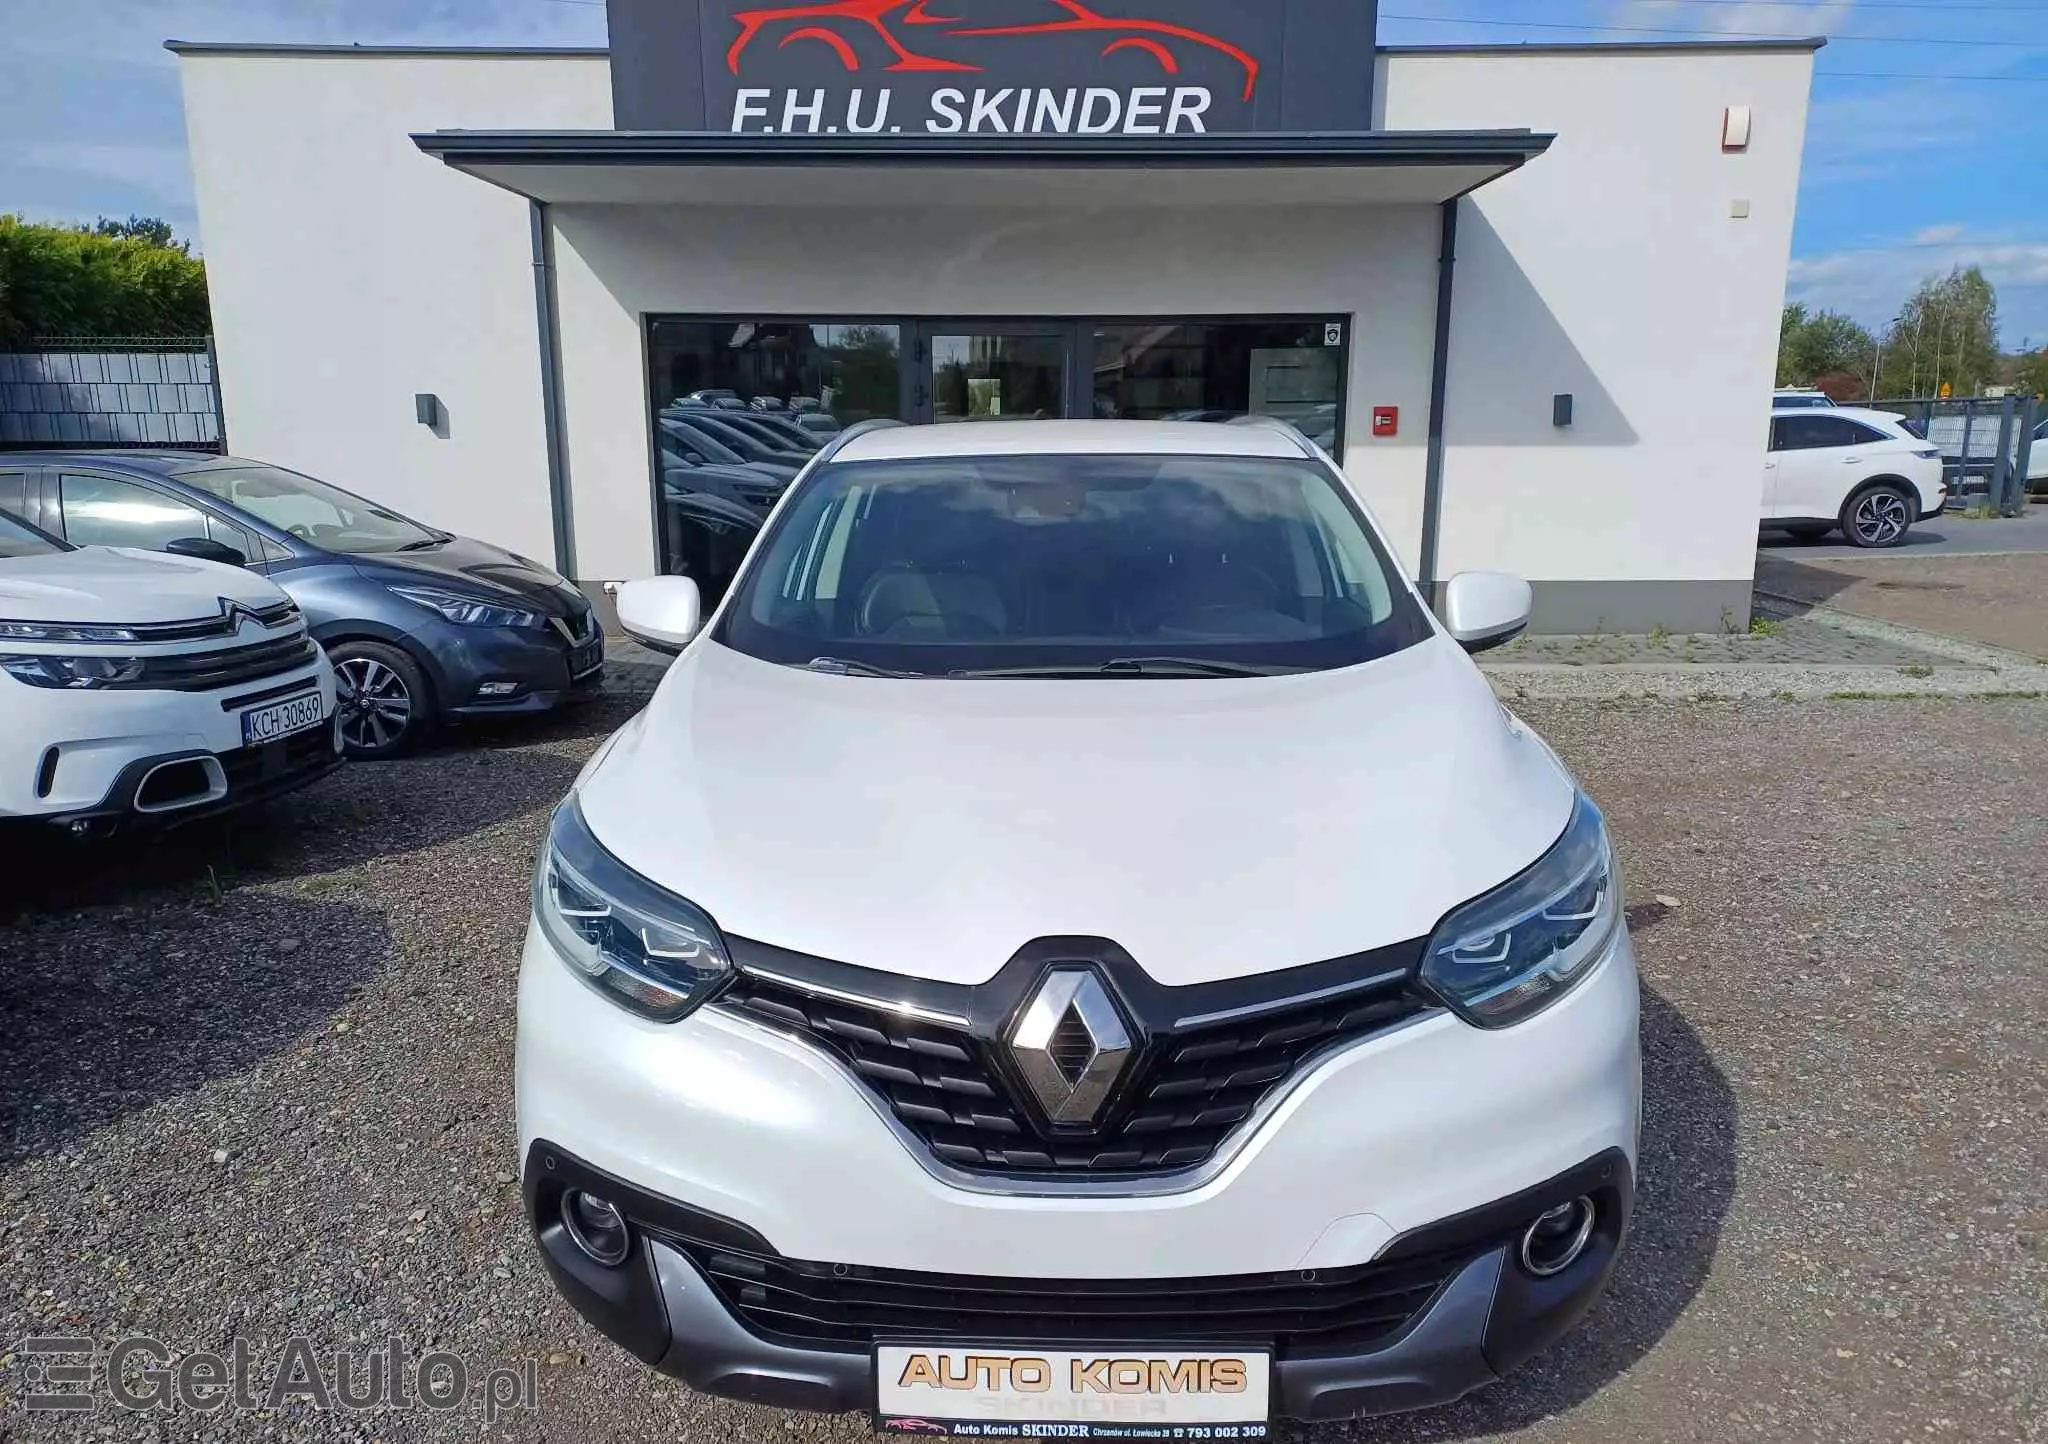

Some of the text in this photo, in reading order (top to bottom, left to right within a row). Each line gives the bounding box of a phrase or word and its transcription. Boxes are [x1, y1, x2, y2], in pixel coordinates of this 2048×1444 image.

[731, 87, 1211, 133] F.H.U. SKINDER
[252, 697, 319, 739] KCH 30869
[898, 1354, 1248, 1394] AUTO KOMIS
[953, 1423, 980, 1435] Auto
[983, 1424, 1019, 1435] Komis
[1022, 1424, 1090, 1437] SKINDER
[1186, 1427, 1211, 1438] 793
[1214, 1427, 1239, 1438] 002
[1242, 1426, 1267, 1437] 309
